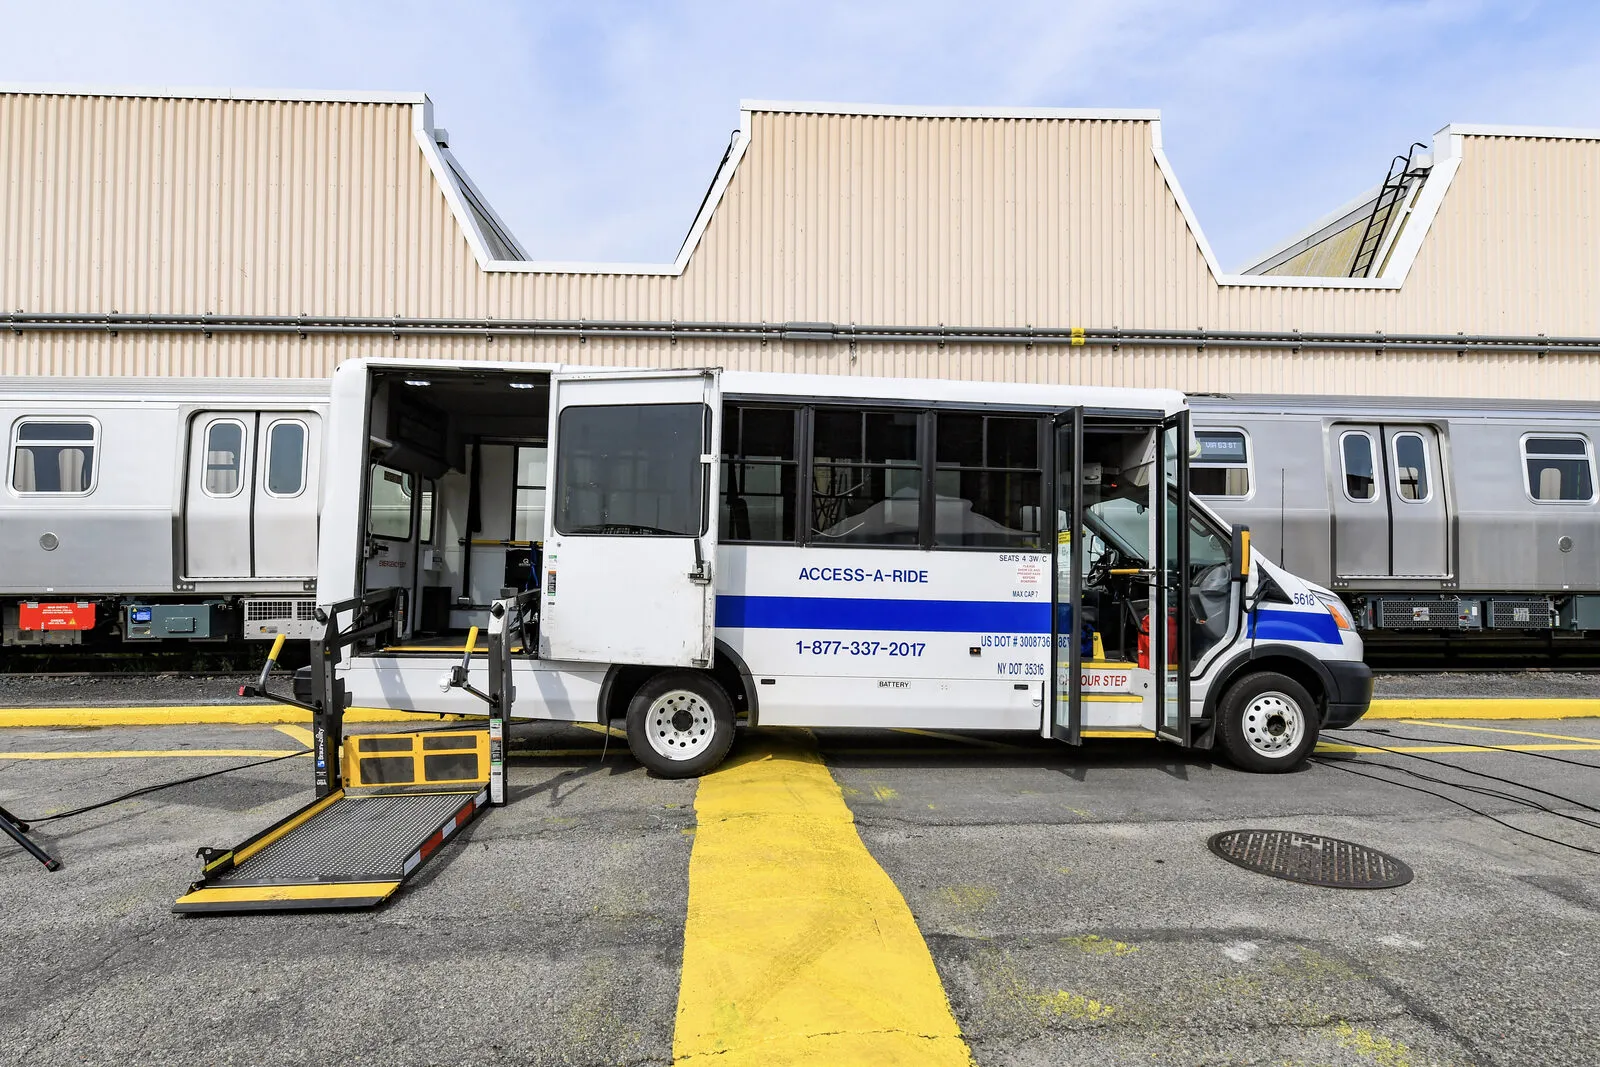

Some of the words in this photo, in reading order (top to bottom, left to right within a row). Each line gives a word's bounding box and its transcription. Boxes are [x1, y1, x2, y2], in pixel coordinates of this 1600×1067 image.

[999, 554, 1020, 562] SEATS
[1028, 555, 1047, 563] 3W/C
[798, 567, 929, 584] ACCESS-A-RIDE
[1012, 590, 1024, 598] MAX
[1024, 590, 1034, 598] CAP
[1293, 592, 1315, 606] 5618
[980, 635, 993, 648] US
[994, 635, 1012, 648] DOT
[1012, 635, 1018, 648] #
[1019, 635, 1051, 648] 3008736
[795, 640, 927, 658] 1-877-337-2017
[997, 662, 1008, 675] NY
[1008, 662, 1023, 676] DOT
[1024, 662, 1045, 676] 35316
[878, 680, 909, 689] BATTERY
[1080, 674, 1100, 687] OUR
[1103, 675, 1127, 687] STEP
